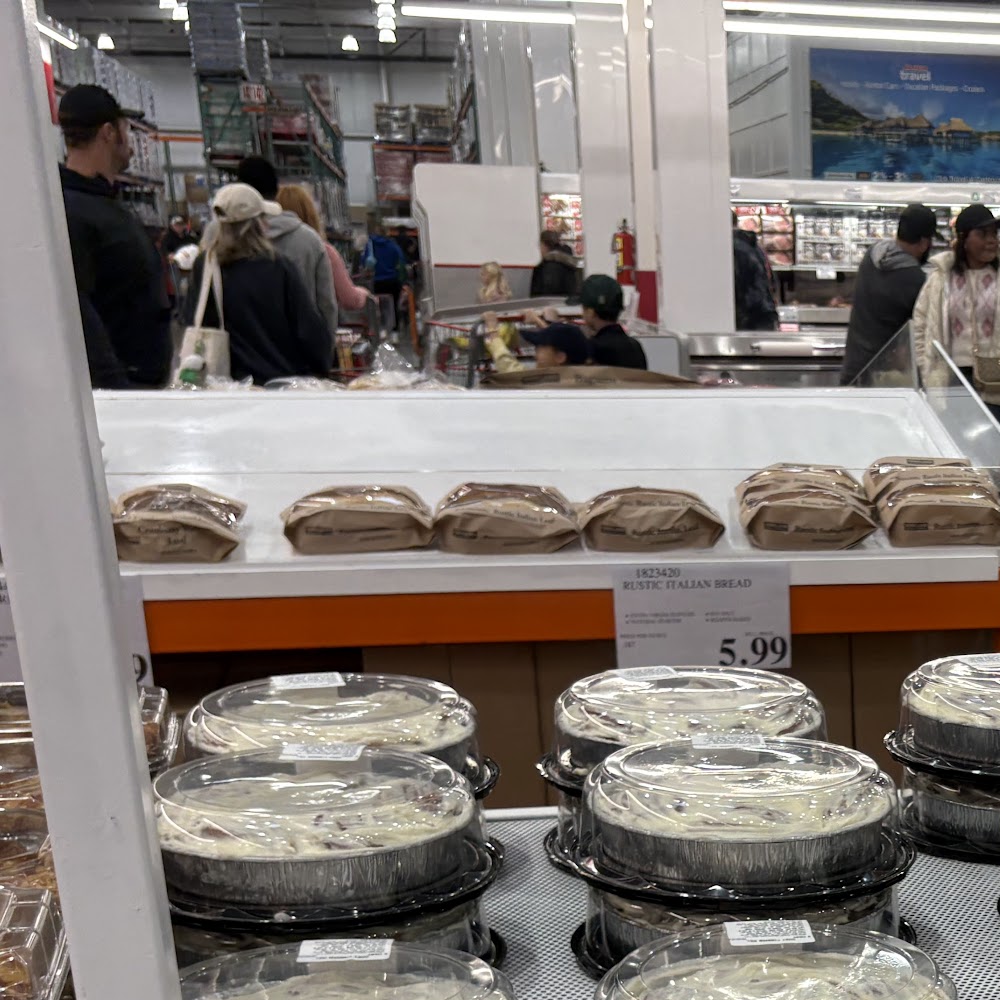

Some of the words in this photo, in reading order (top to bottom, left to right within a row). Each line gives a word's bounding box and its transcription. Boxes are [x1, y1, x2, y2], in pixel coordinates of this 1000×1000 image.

[636, 567, 681, 579] 1823420
[623, 580, 662, 591] RUSTIC
[666, 579, 711, 590] ITALIAN
[714, 578, 752, 589] BREAD
[719, 636, 787, 666] 5.99
